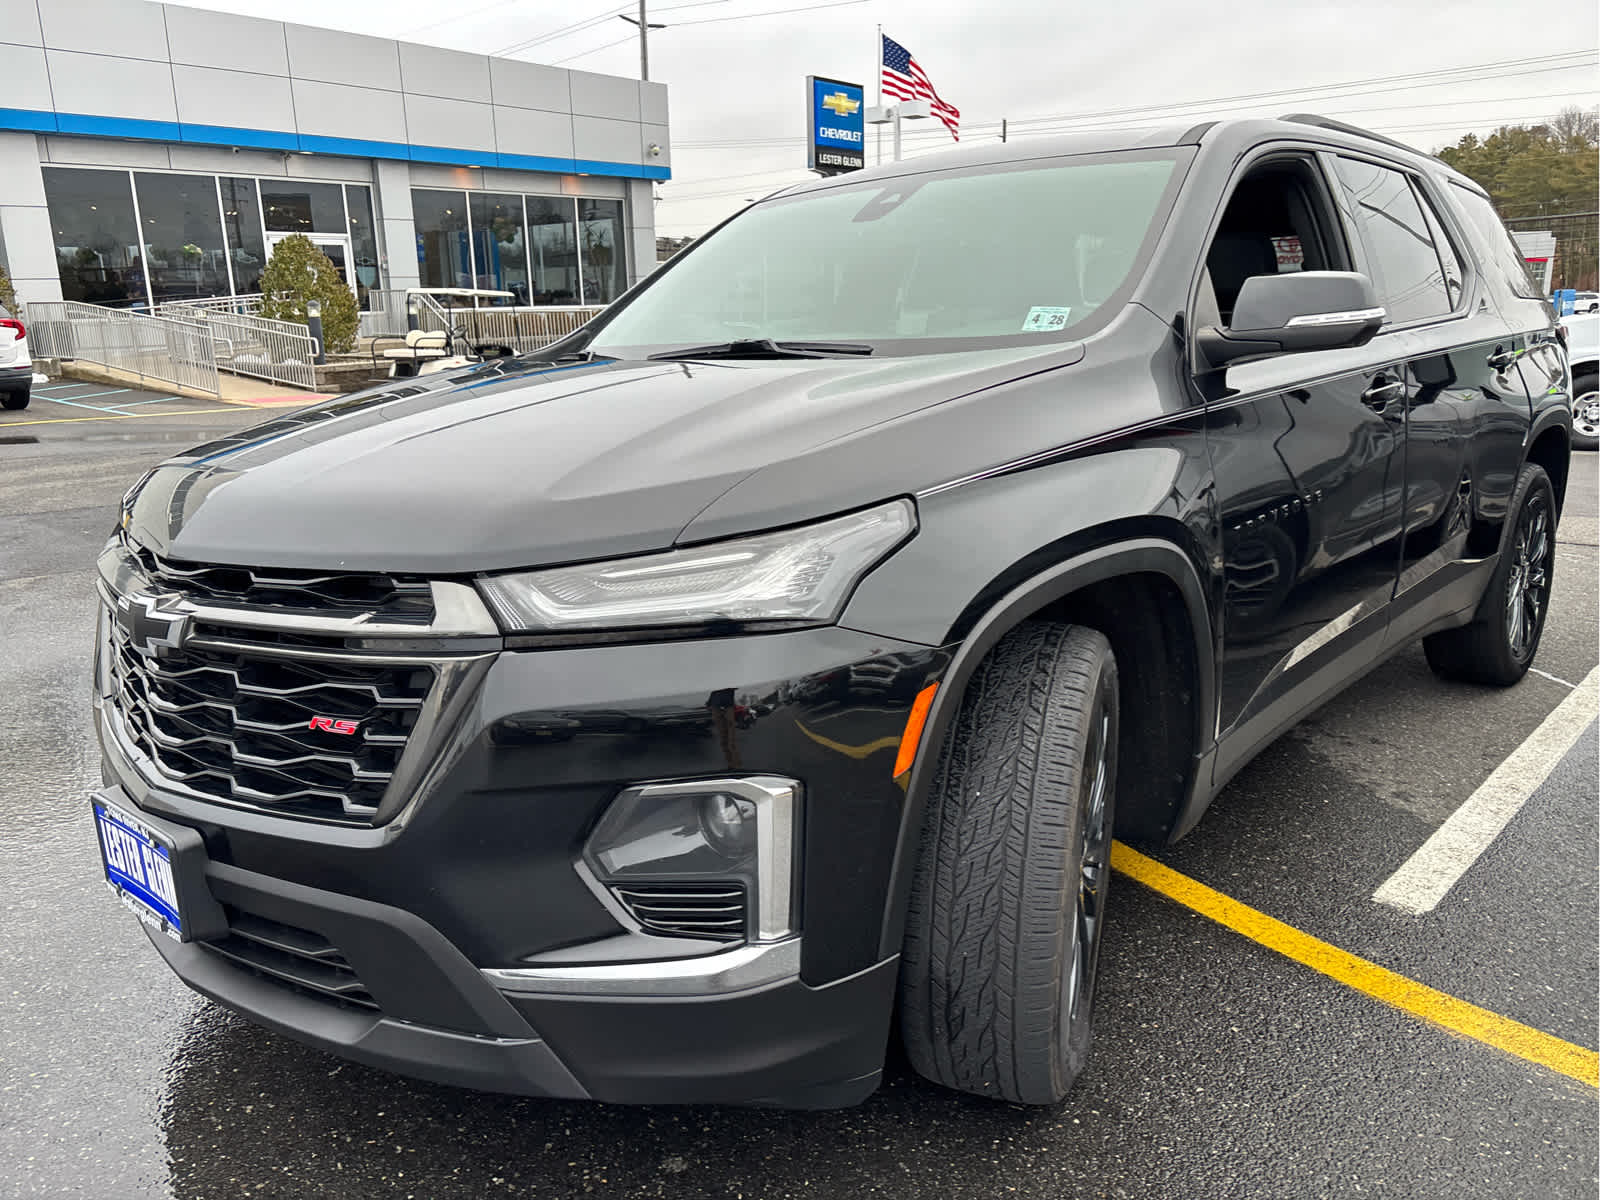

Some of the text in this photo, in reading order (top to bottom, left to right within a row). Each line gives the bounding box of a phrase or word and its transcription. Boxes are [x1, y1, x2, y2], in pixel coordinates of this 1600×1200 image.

[820, 127, 862, 142] CHEVROLET
[819, 153, 863, 168] LESTER GLENN
[1032, 313, 1065, 325] 4 28
[309, 715, 360, 735] RS
[100, 818, 146, 886] LESTER
